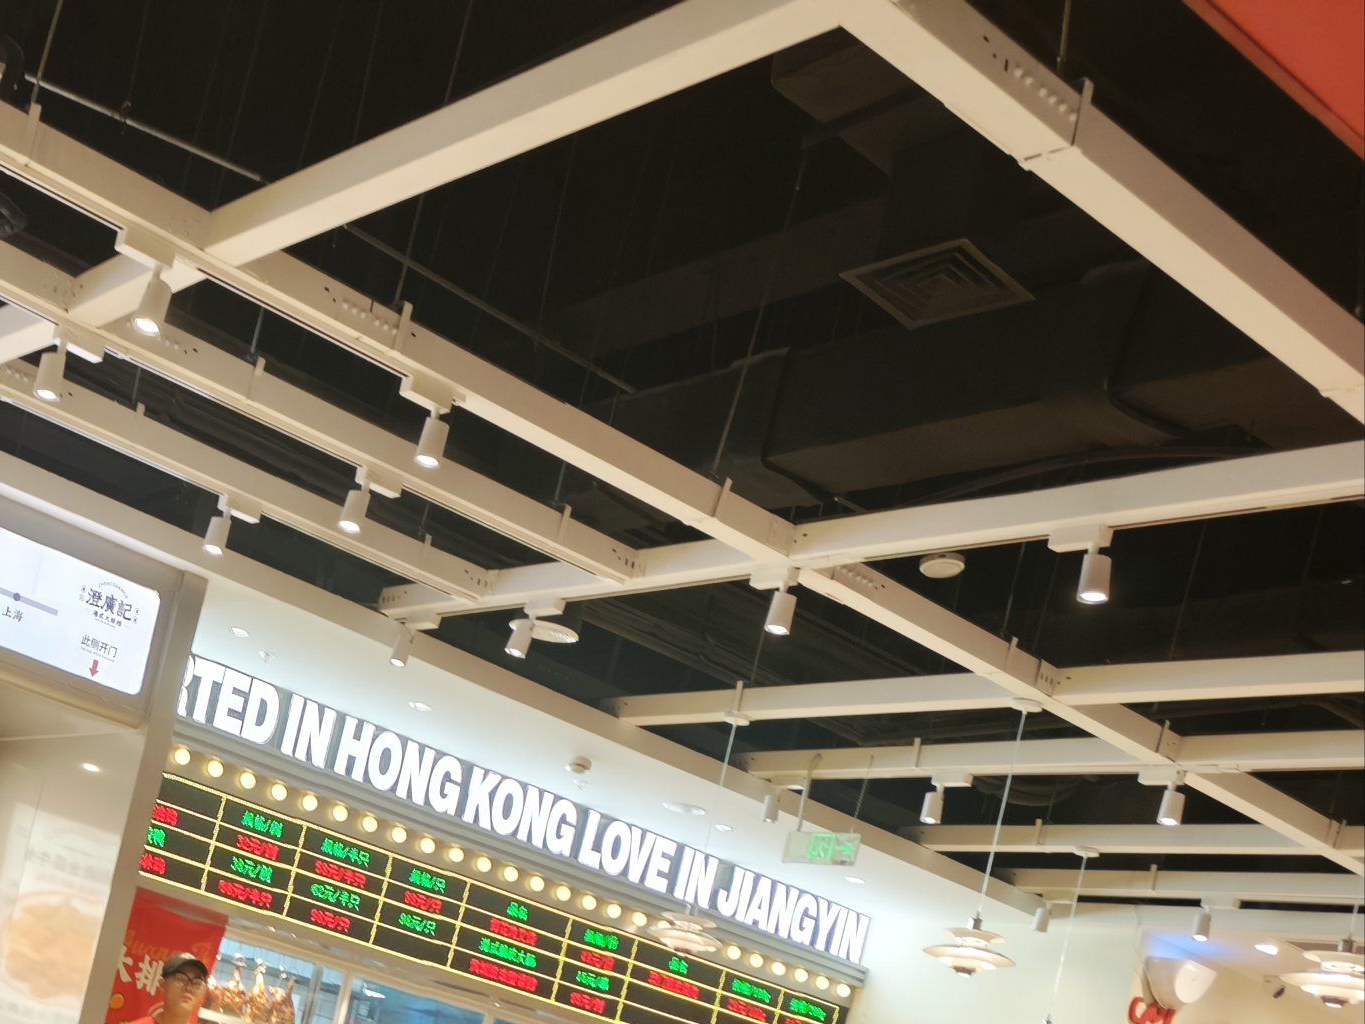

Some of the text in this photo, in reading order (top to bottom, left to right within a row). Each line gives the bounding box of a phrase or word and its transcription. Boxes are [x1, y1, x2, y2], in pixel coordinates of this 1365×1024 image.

[1, 605, 24, 623] 上海
[84, 587, 133, 622] 澄廣記
[80, 634, 118, 658] 此侧开门
[281, 692, 336, 770] IN
[334, 714, 464, 816] HONG
[463, 765, 579, 858] KONG
[577, 808, 679, 896] LOVE
[673, 843, 720, 911] IN
[716, 863, 872, 968] JIANGYIN
